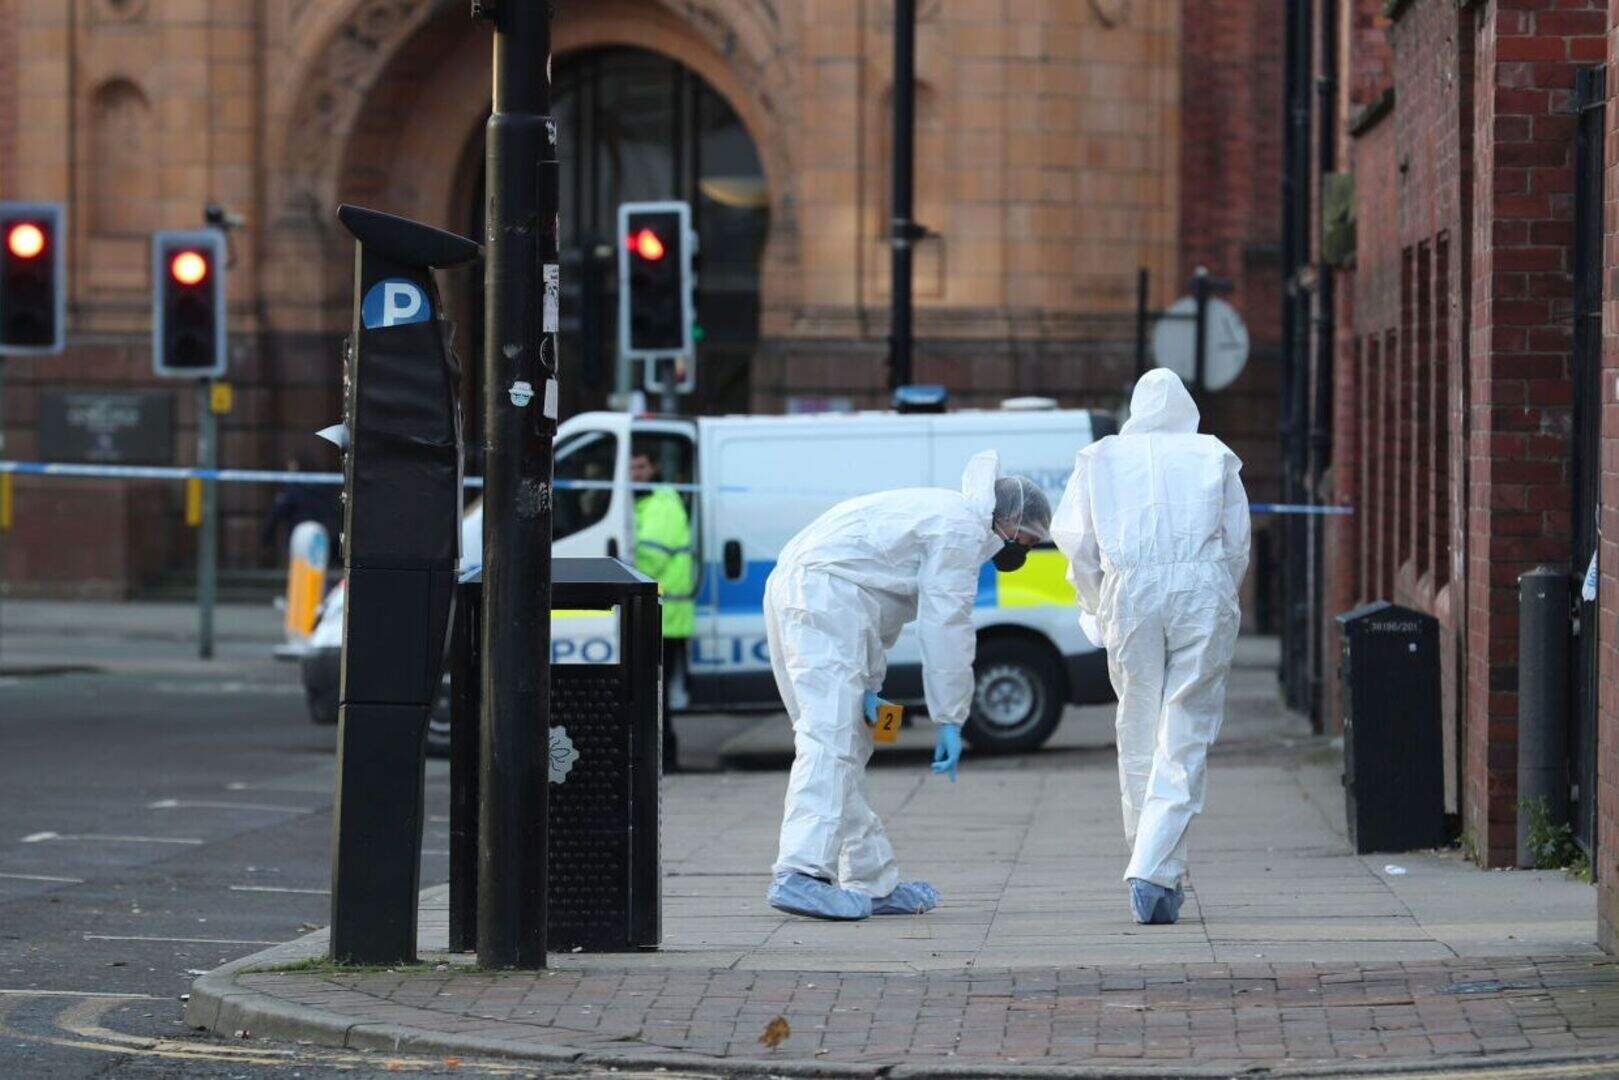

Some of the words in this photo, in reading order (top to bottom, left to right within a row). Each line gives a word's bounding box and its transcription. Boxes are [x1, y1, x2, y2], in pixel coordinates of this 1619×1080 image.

[383, 282, 421, 326] P
[692, 636, 770, 664] LIC
[883, 712, 894, 731] 2
